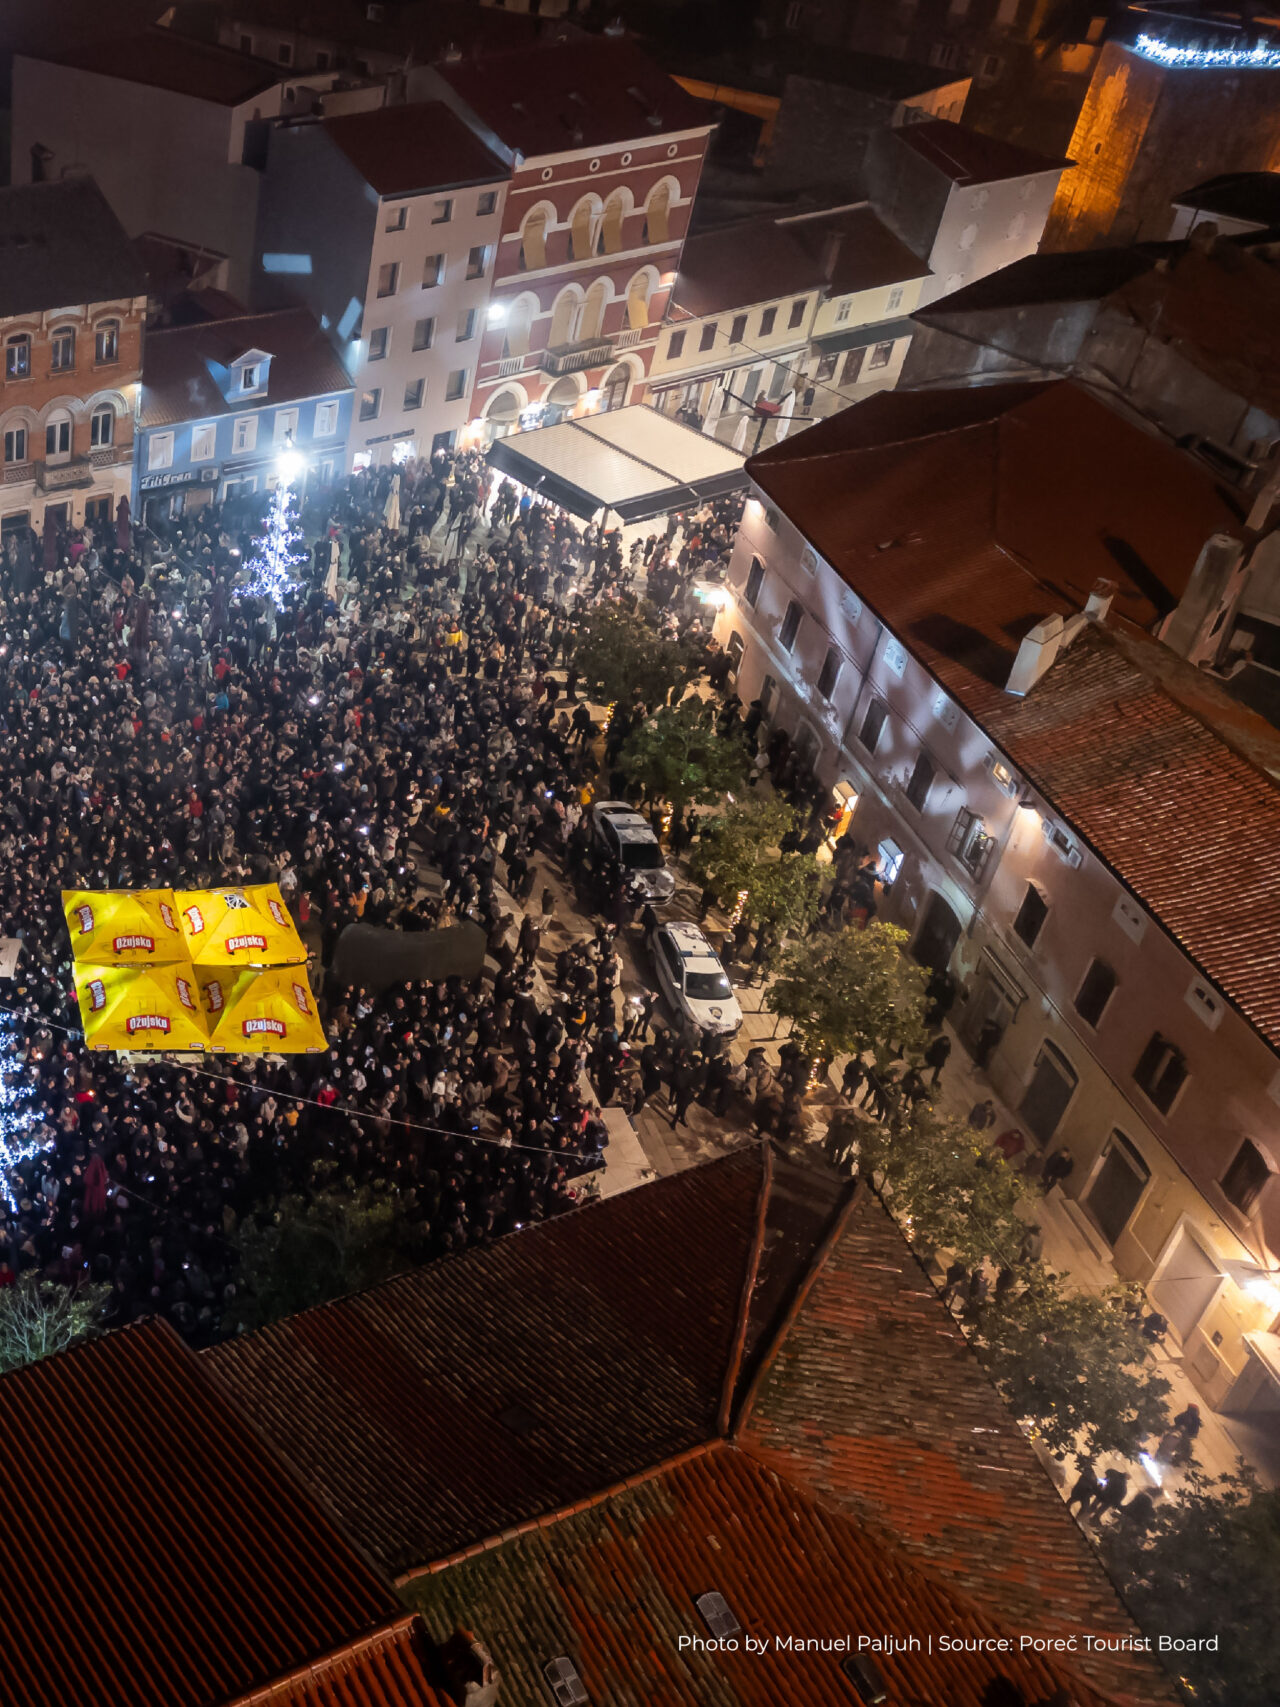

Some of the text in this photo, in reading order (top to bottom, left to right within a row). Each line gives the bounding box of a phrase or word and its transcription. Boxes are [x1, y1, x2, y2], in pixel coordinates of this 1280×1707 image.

[116, 936, 152, 949] Ožujsko
[228, 935, 264, 950] Ožujsko
[129, 1015, 167, 1029] Ožujsko
[246, 1019, 283, 1033] Ožujsko
